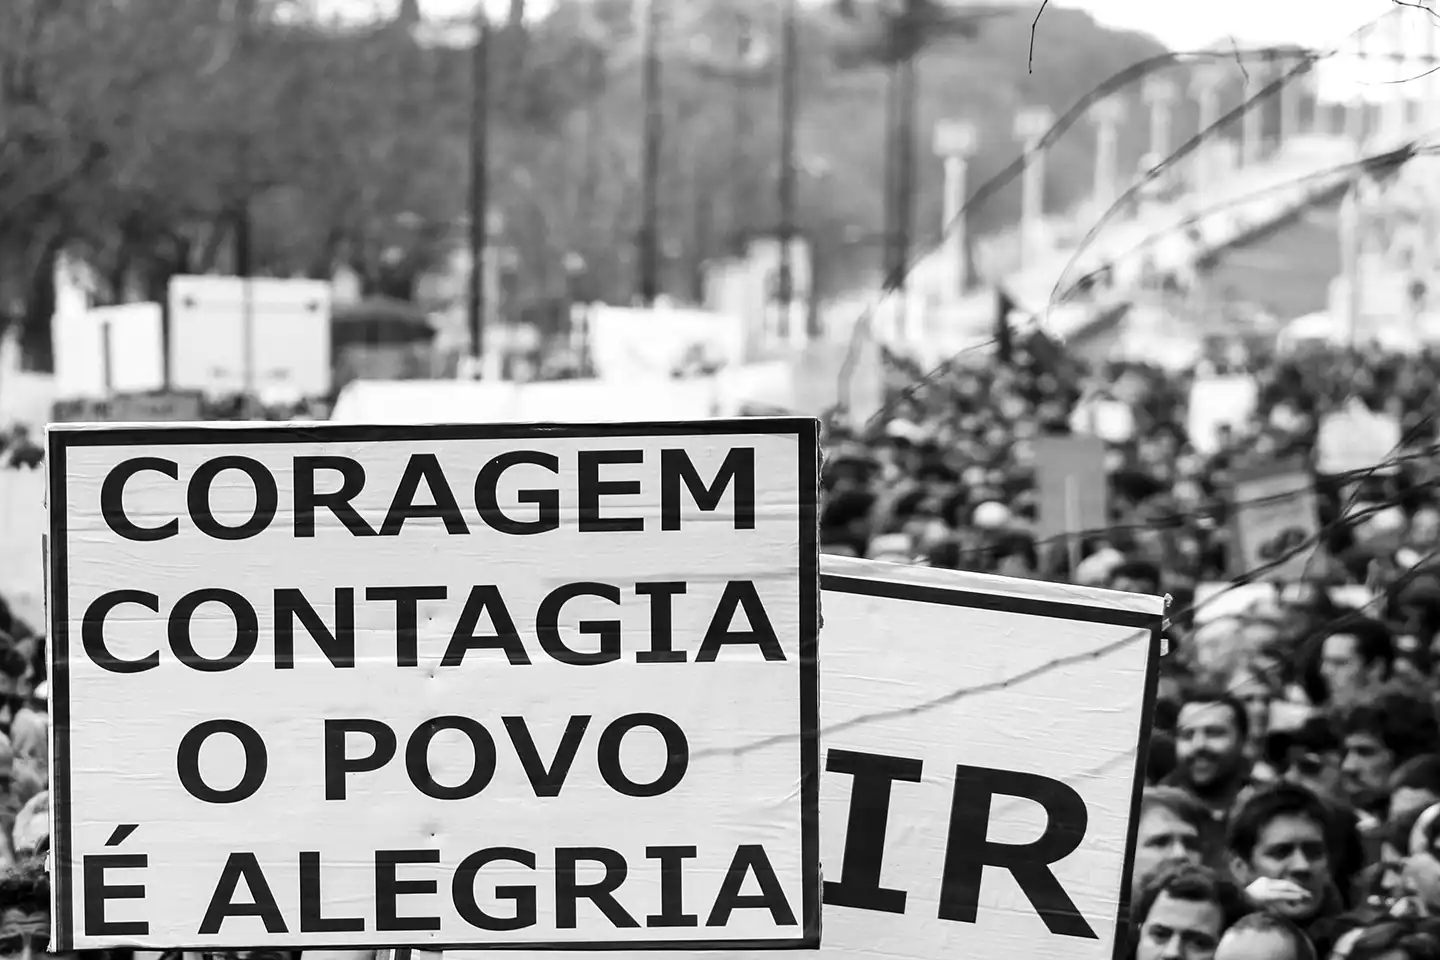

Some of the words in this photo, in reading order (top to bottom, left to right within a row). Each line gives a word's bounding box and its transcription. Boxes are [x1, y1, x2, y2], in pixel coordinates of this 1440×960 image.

[99, 447, 755, 541] CORAGEM
[81, 580, 787, 673] CONTAGIA
[176, 718, 268, 803] O
[324, 713, 689, 801] POVO
[83, 824, 150, 936] É
[198, 843, 799, 935] ALEGRIA
[823, 748, 1099, 939] IR
